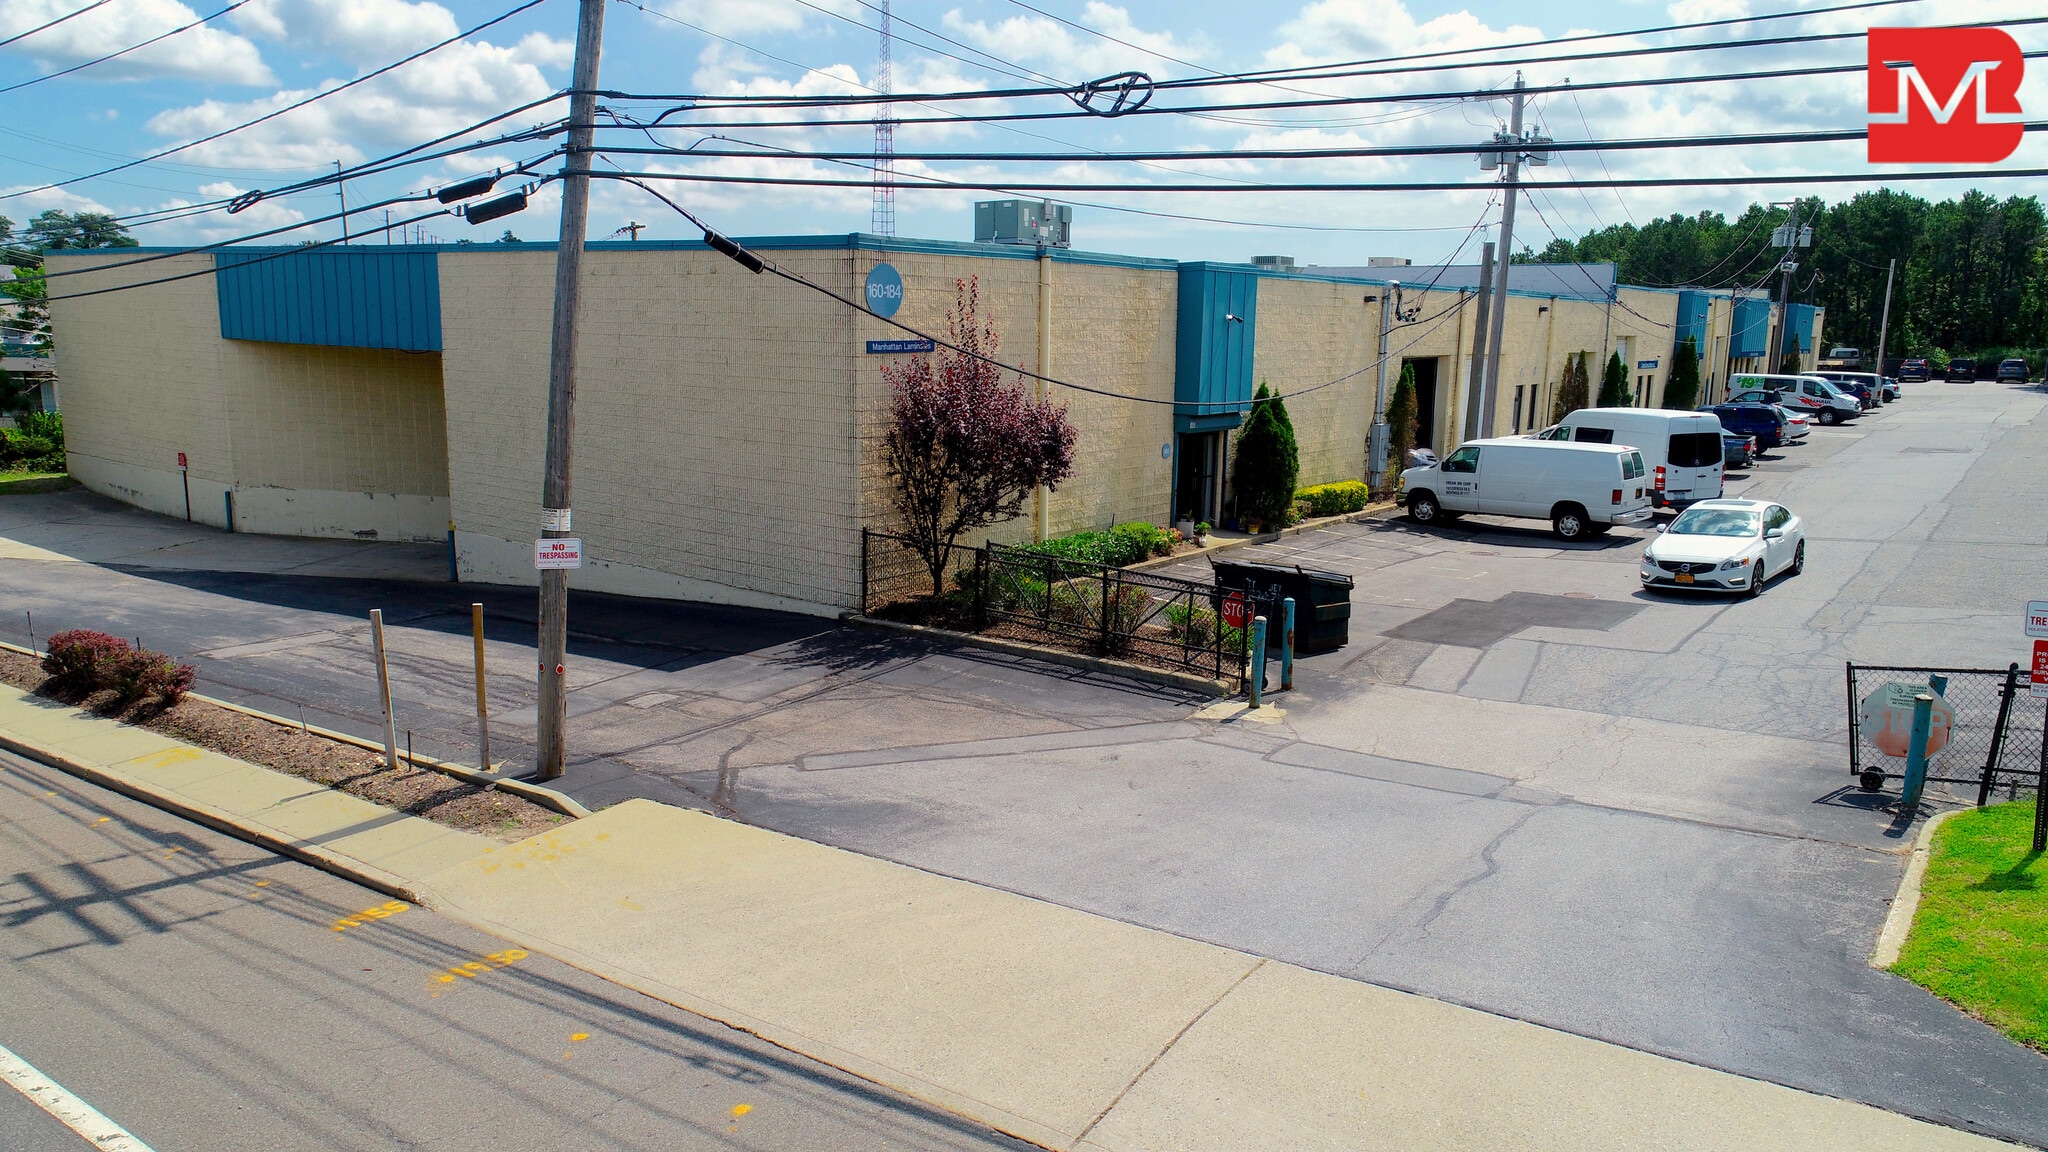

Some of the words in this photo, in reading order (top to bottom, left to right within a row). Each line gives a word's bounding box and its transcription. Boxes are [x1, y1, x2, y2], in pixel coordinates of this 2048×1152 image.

[867, 283, 901, 298] 160-184
[872, 342, 902, 351] Manhattan
[552, 543, 565, 551] NO
[539, 551, 579, 560] TRESPASSING
[1223, 602, 1251, 618] STO
